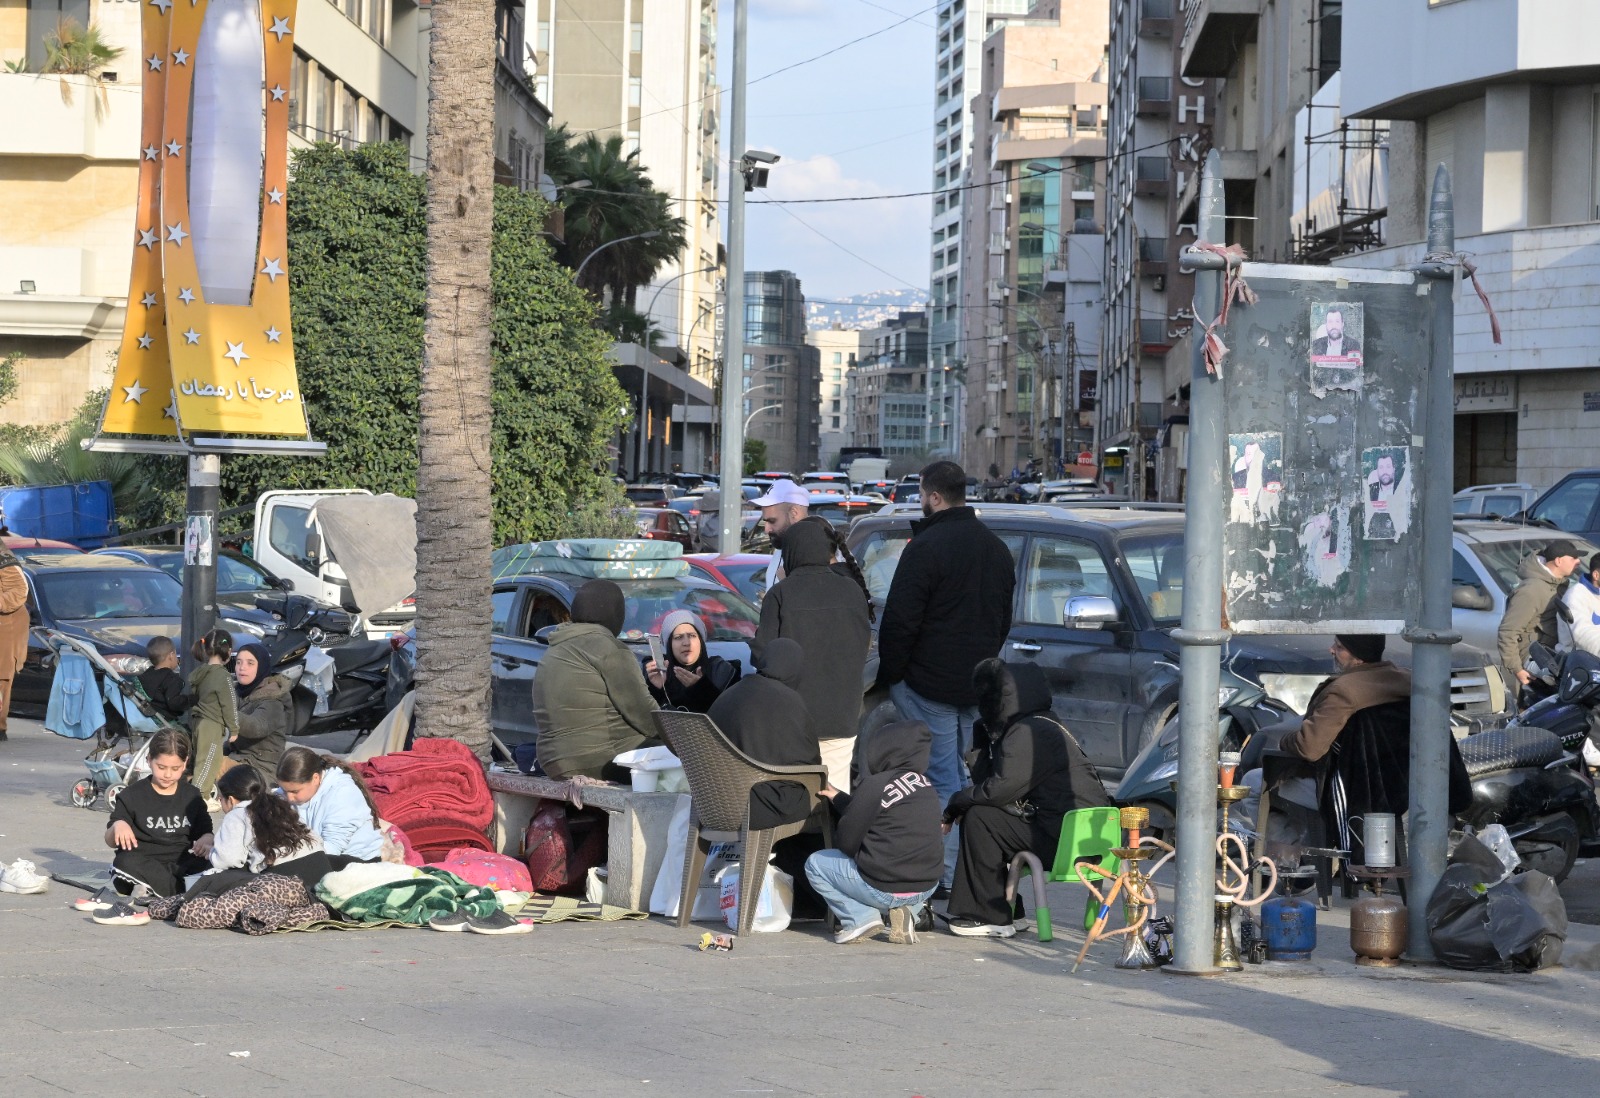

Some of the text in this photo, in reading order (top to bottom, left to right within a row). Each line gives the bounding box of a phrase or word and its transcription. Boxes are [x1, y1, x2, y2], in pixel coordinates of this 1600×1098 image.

[181, 378, 234, 401] رمضان
[235, 380, 248, 400] يا
[1480, 379, 1509, 402] بناية
[146, 815, 191, 829] SALSA
